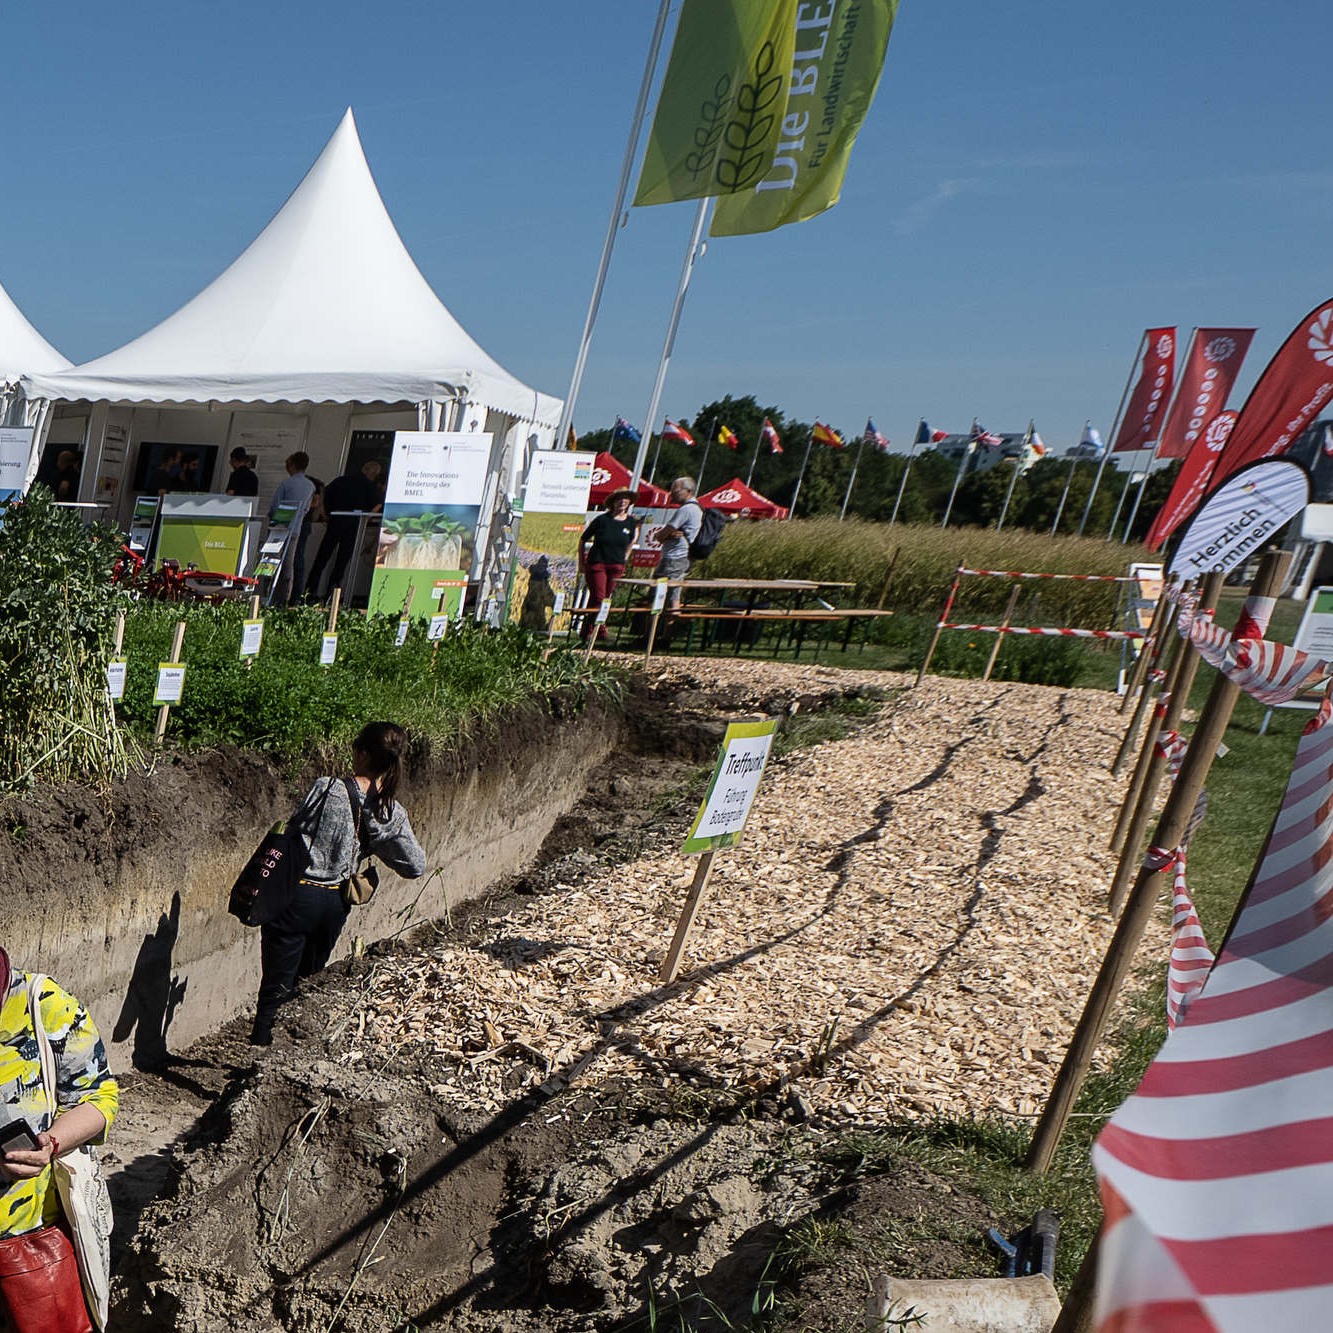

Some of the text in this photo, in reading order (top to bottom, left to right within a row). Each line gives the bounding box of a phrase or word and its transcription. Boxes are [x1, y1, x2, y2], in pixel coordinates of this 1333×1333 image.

[809, 5, 861, 168] Für Landwirtschaft
[1189, 508, 1261, 568] Herzlich
